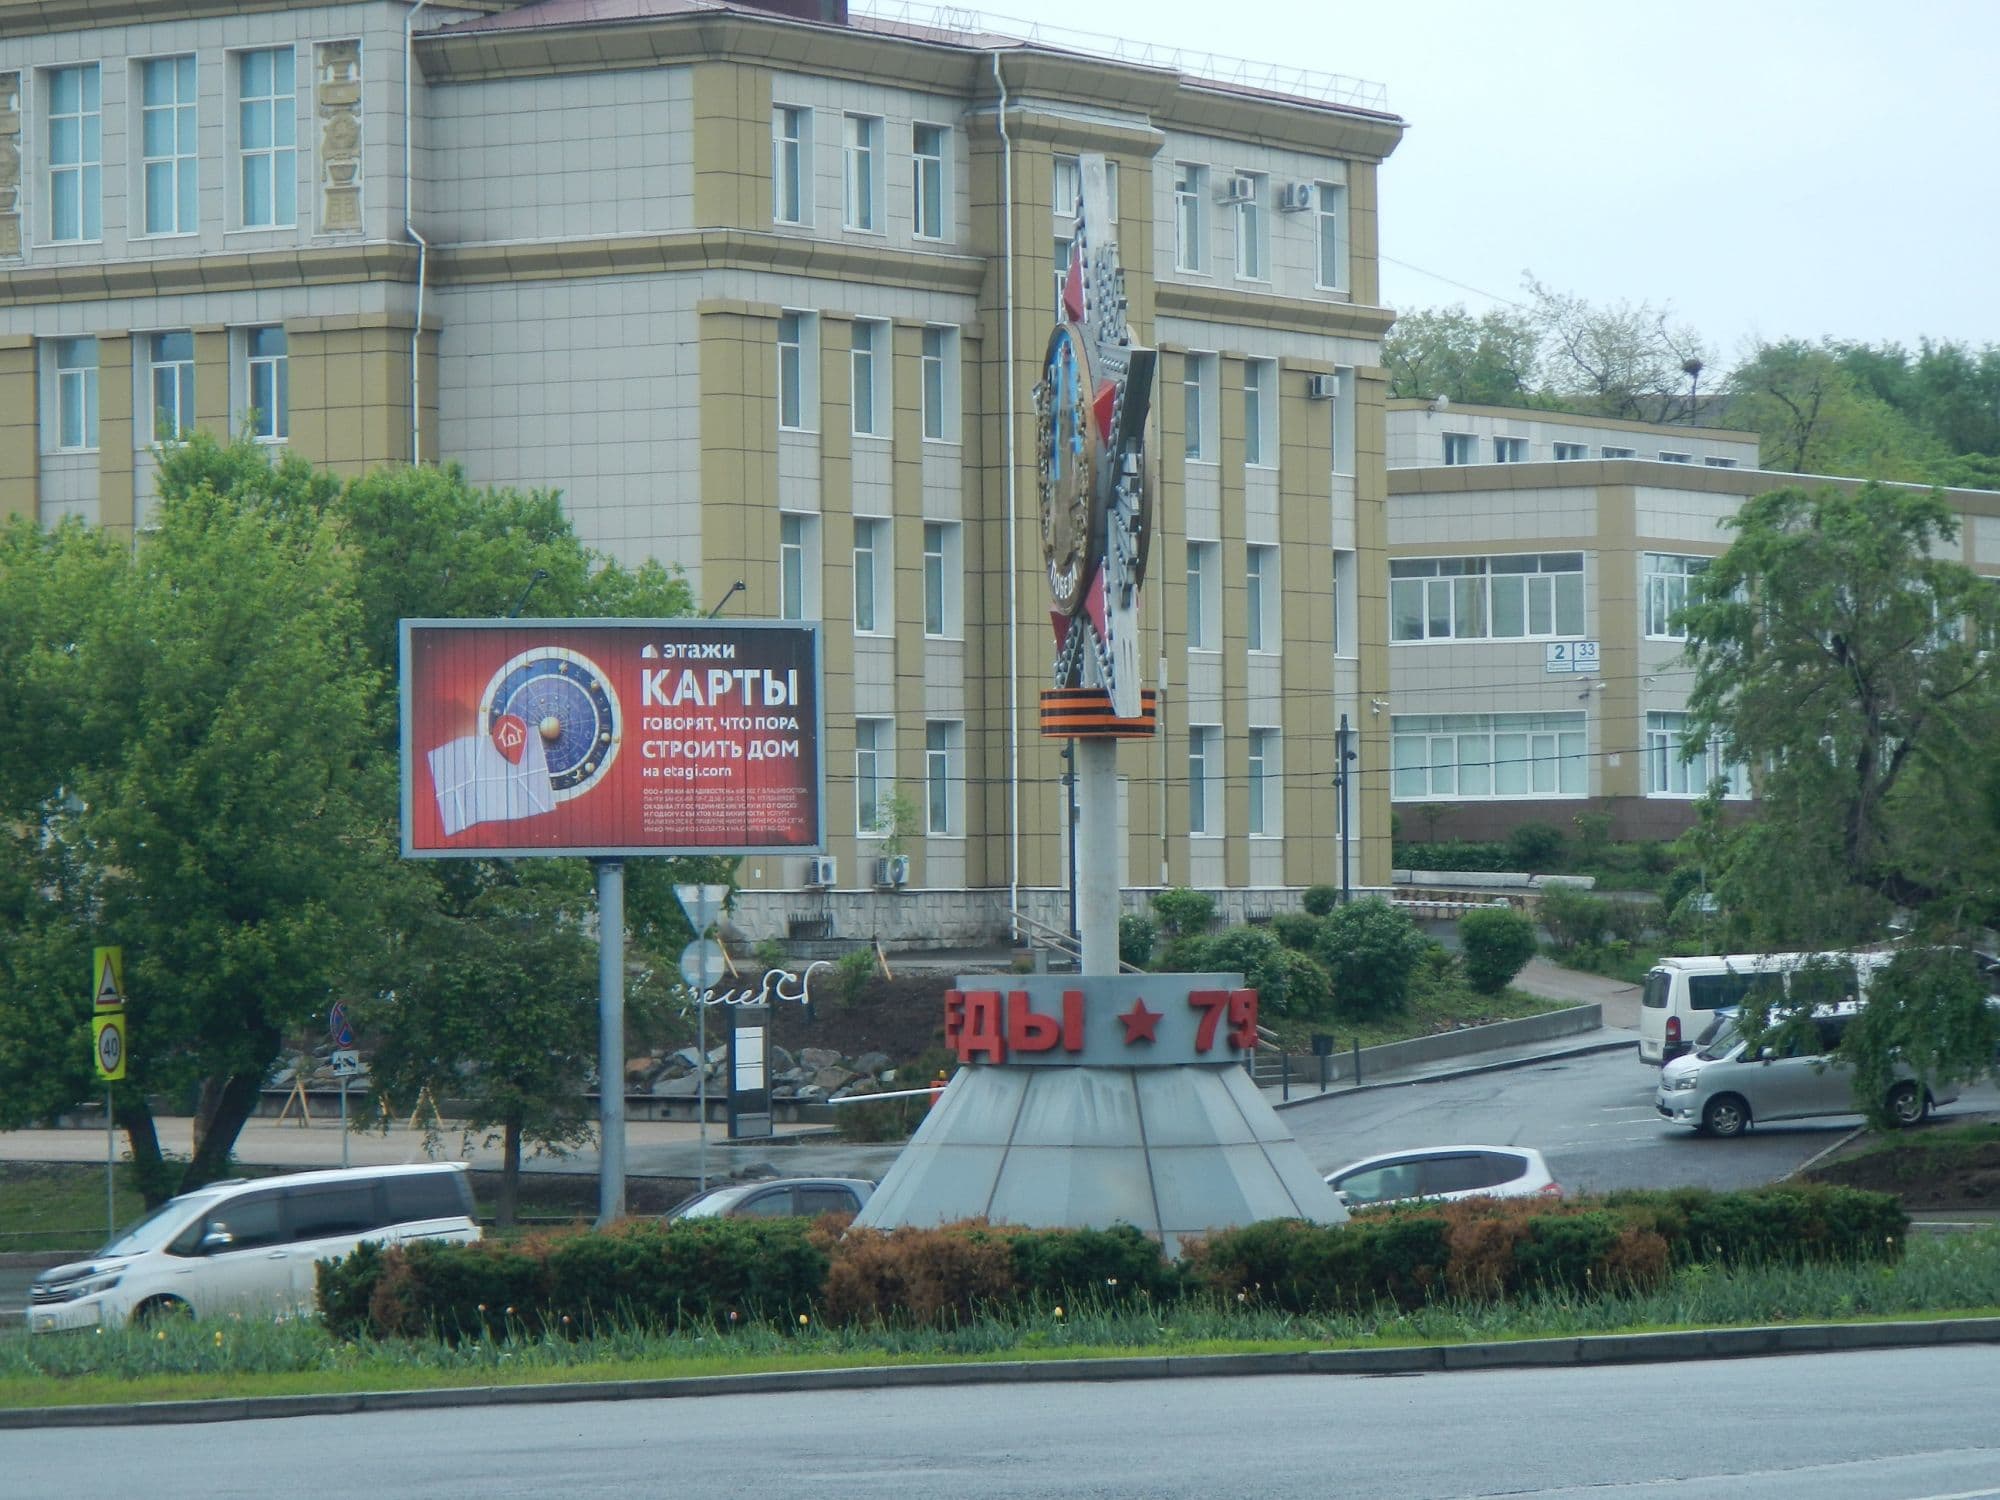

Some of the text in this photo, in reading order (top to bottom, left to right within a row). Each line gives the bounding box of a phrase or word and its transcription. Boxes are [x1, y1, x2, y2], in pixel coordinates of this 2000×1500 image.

[663, 643, 736, 659] этажи
[1555, 644, 1565, 660] 2
[1579, 643, 1595, 656] 33
[641, 668, 798, 706] КАРТЫ
[642, 716, 799, 732] ГОВОРЯТ, ЧТО ПОРА
[642, 739, 799, 760] СТРОИТЬ ДОМ
[643, 764, 732, 780] на etagi.com
[103, 1037, 118, 1057] 40
